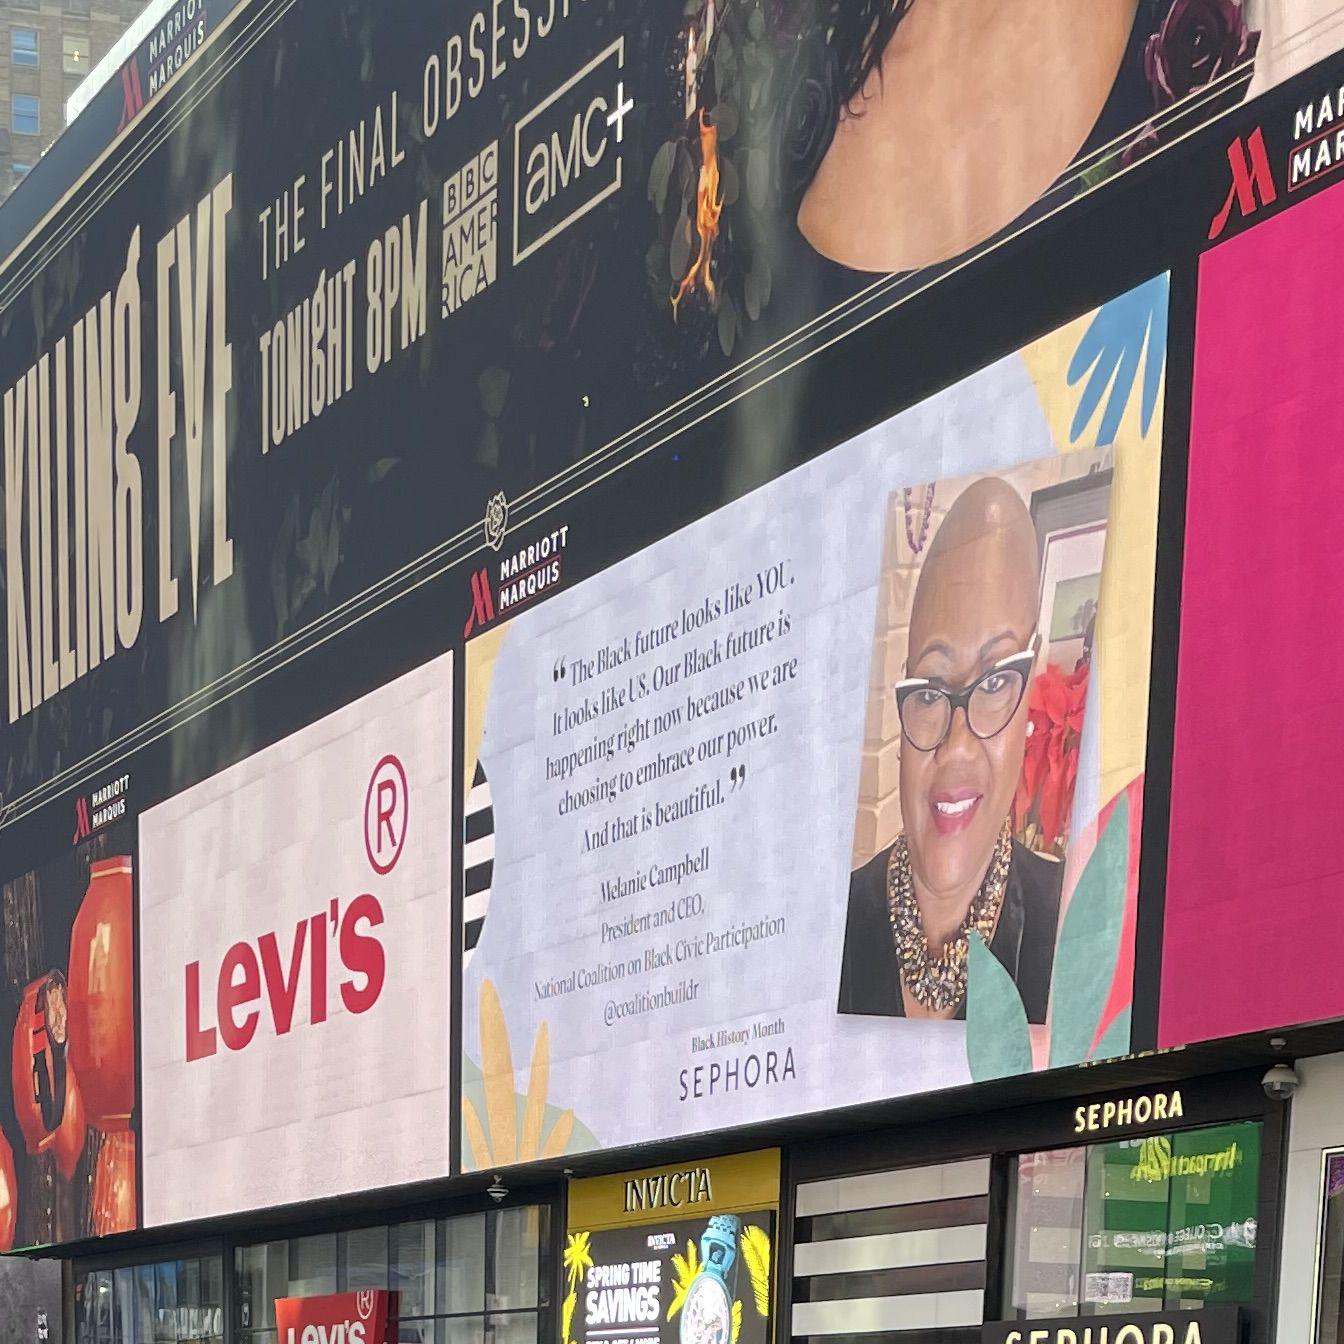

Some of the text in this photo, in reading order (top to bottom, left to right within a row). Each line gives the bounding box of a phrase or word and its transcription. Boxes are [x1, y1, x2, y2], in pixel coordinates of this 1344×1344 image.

[150, 0, 203, 63] MARRIO
[150, 20, 204, 97] MARQUIS
[259, 174, 306, 281] THE
[321, 90, 406, 229] FINAL
[445, 146, 496, 218] BBC
[259, 198, 428, 454] TONIGHT 8PM
[4, 172, 234, 724] KILLING EVE
[500, 526, 568, 581] MARRIOTT
[499, 561, 560, 610] MARQUIS
[597, 638, 632, 675] Black
[634, 618, 679, 658] future
[681, 597, 721, 635] looks
[724, 583, 753, 615] like
[553, 711, 563, 737] It
[564, 698, 599, 730] looks
[601, 687, 626, 717] like
[653, 662, 681, 692] Our
[684, 638, 722, 679] Black
[725, 619, 775, 660] future
[778, 608, 792, 637] is
[545, 657, 799, 780] happening right now because we are
[92, 774, 130, 808] MARRIOTT
[558, 713, 779, 816] choosing to embrace our power.
[92, 798, 126, 830] MARQUIS
[581, 821, 609, 854] And
[611, 812, 638, 844] that
[641, 806, 653, 833] is
[655, 778, 725, 828] beautiful.
[600, 845, 710, 905] Melanie Campbell
[600, 914, 651, 944] President
[653, 901, 676, 929] and
[534, 915, 786, 1001] National Coalition on Black Civic Participation
[691, 1017, 785, 1053] Black History Month
[679, 1046, 796, 1101] SEPHORA
[1074, 1090, 1184, 1133] SEPHORA
[623, 1166, 713, 1213] INVICTA
[587, 1260, 662, 1288] SPRING TIME
[585, 1286, 660, 1325] SAVINGS
